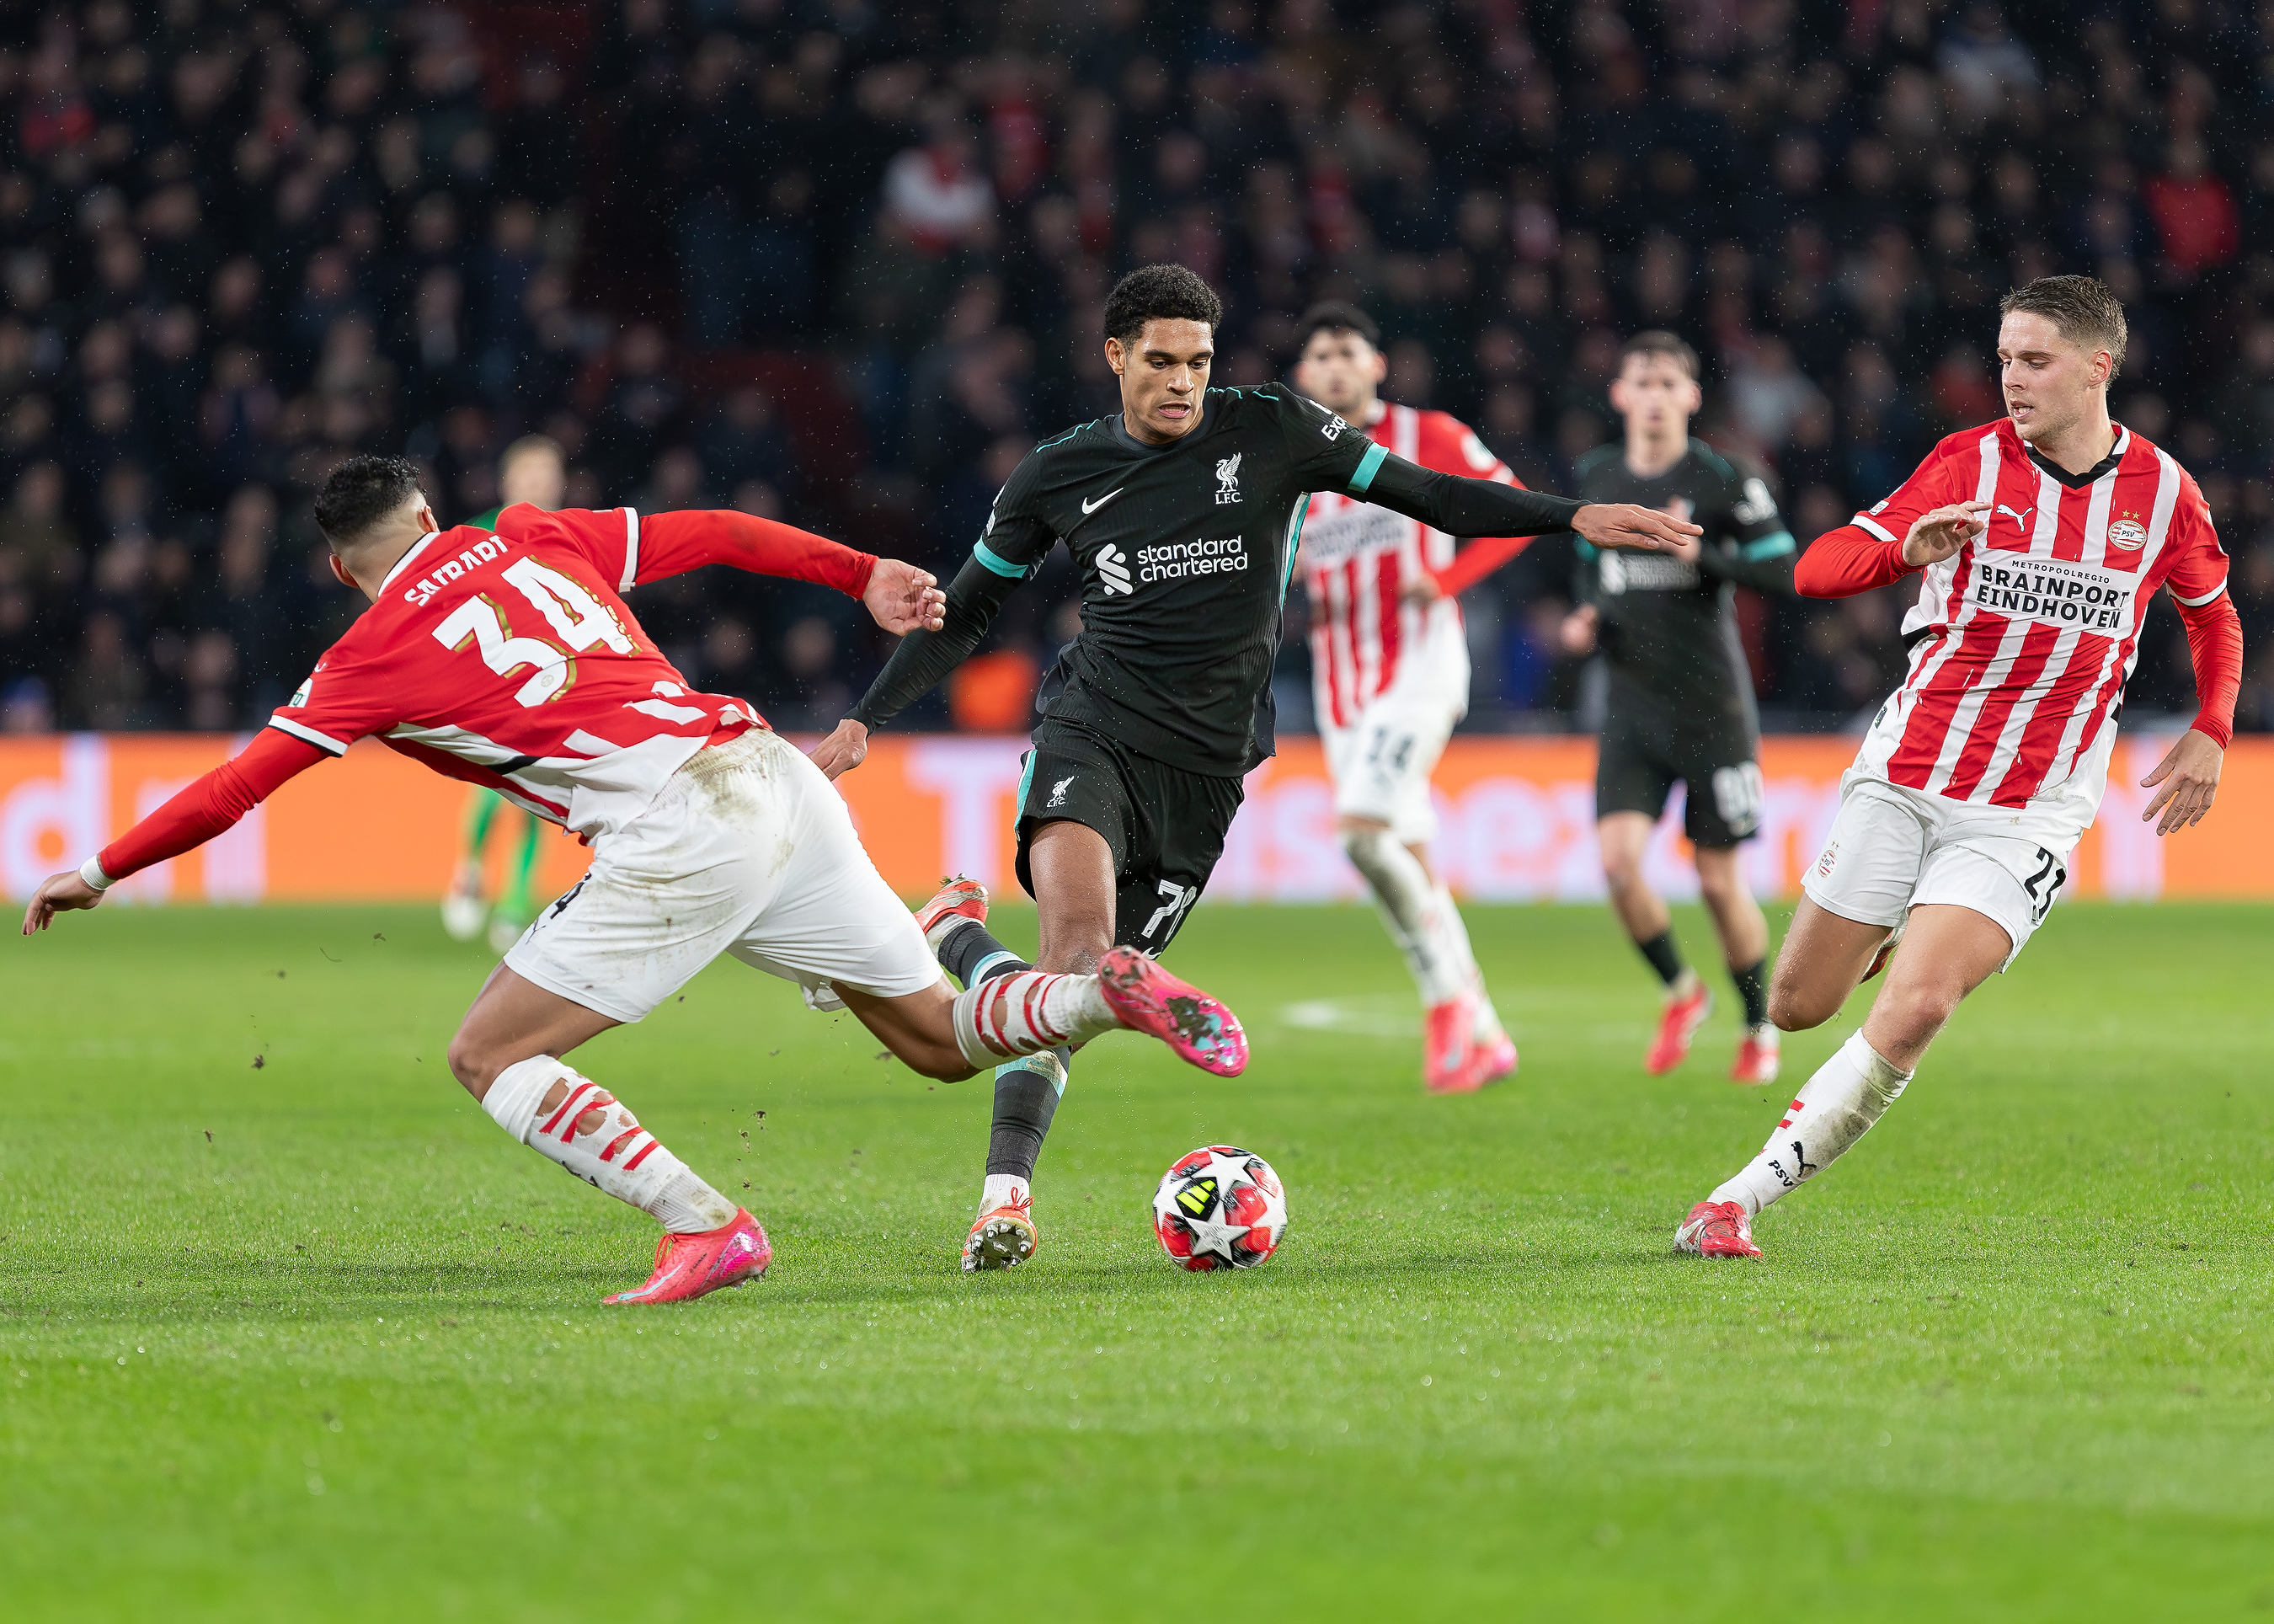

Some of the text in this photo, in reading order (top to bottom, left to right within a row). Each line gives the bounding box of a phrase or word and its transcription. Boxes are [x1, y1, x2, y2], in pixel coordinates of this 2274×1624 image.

[1137, 535, 1242, 565] standard
[1140, 552, 1248, 582] chartered
[2012, 559, 2110, 584] METROPOOLREGIO
[1981, 564, 2130, 608] BRAINPORT
[1976, 584, 2121, 629] EINDHOVEN
[431, 554, 643, 708] 34
[1768, 1159, 1795, 1187] PSV
